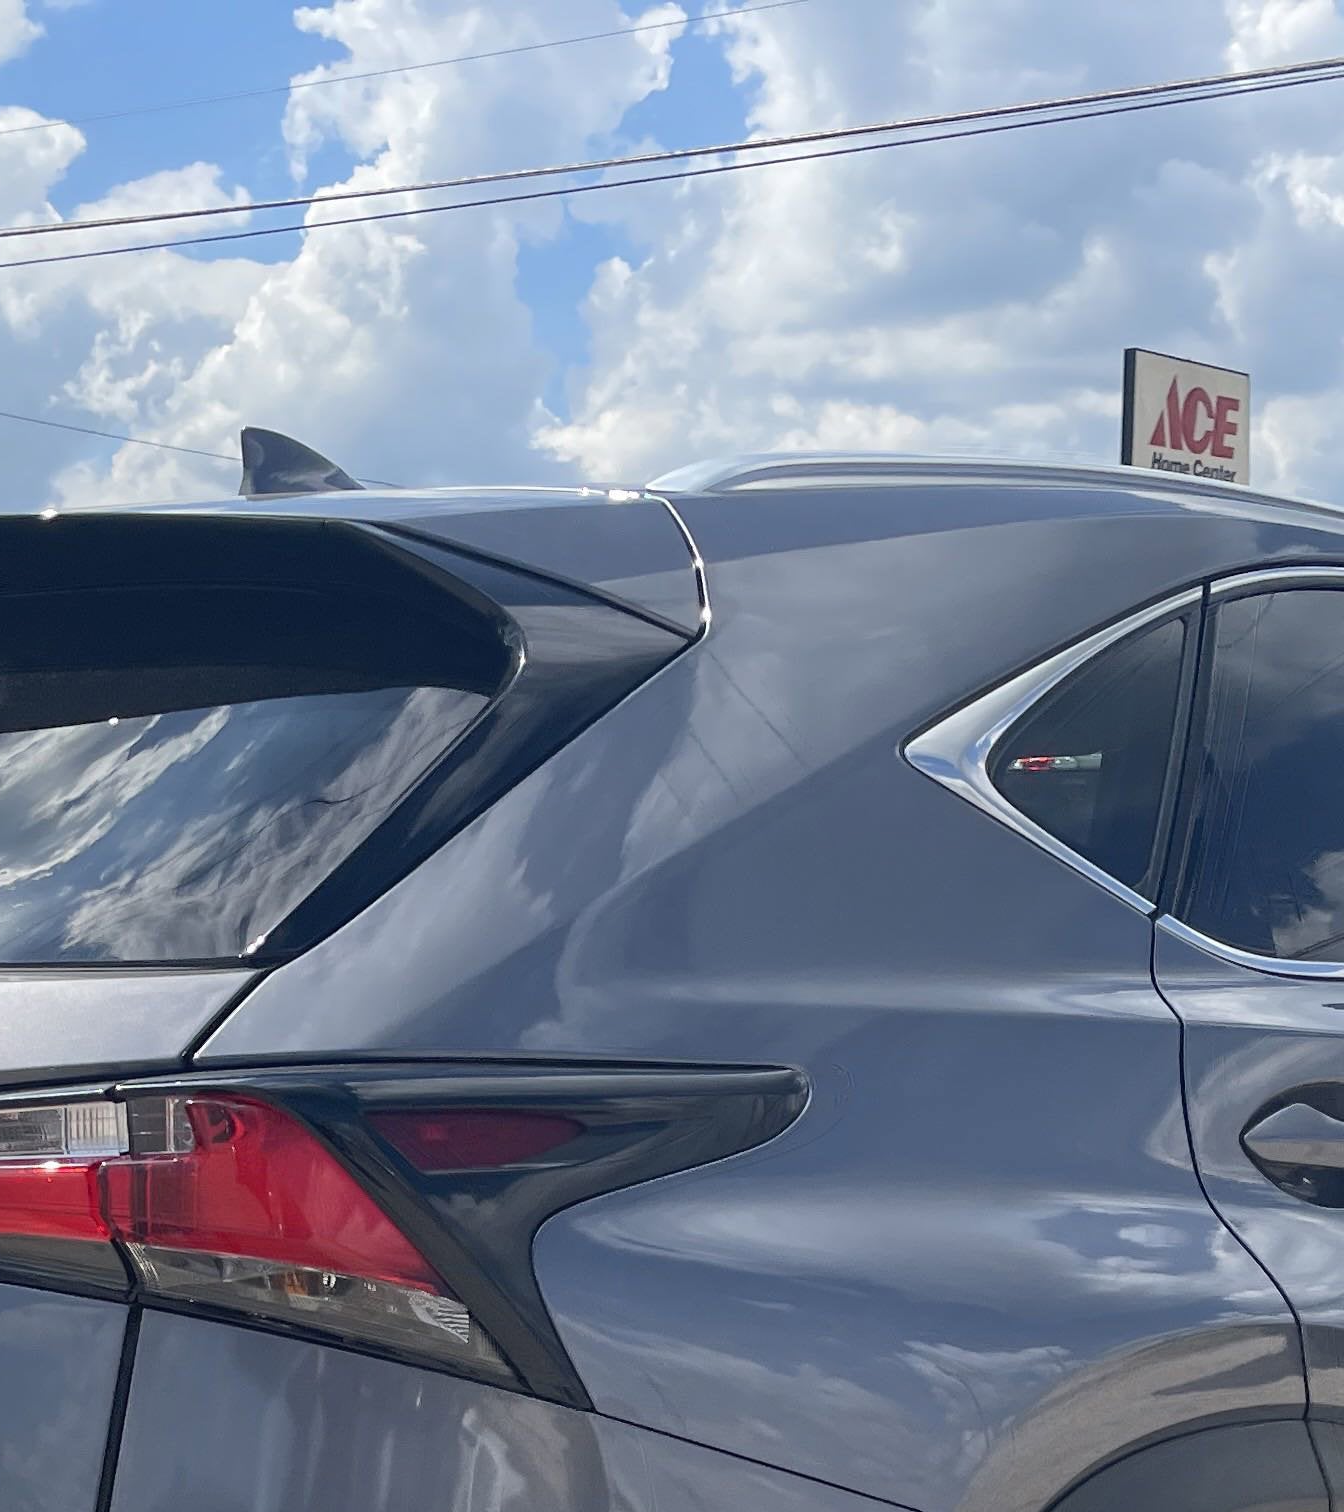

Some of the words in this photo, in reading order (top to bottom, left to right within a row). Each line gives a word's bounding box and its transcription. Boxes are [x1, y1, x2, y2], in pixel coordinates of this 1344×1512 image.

[1149, 374, 1240, 459] ACE
[1151, 452, 1190, 475] Home
[1193, 460, 1238, 483] Center
